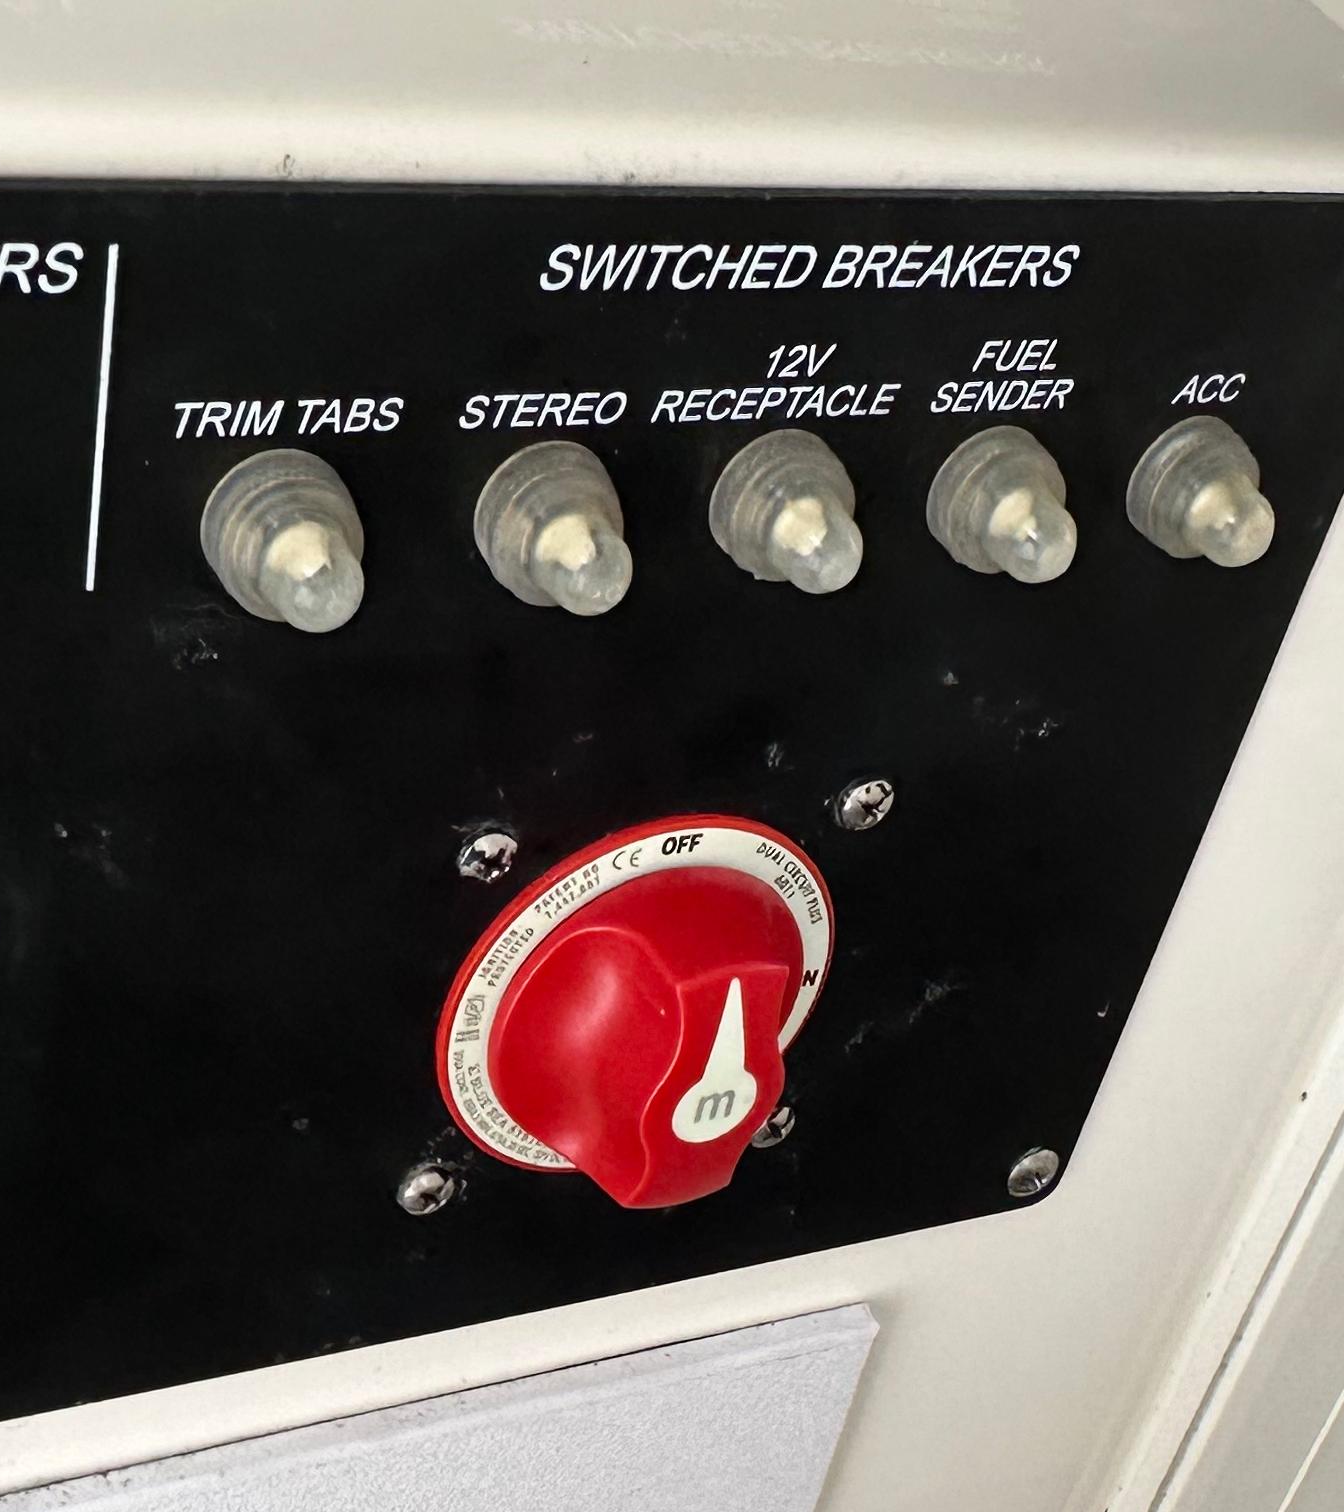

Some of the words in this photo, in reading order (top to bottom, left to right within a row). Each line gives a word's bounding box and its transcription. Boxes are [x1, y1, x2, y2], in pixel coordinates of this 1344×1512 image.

[540, 244, 818, 292] SWITCHED
[821, 245, 1081, 289] BREAKERS
[766, 343, 837, 378] 12V
[972, 338, 1058, 373] FUEL
[651, 383, 902, 423] RECEPTACLE
[930, 378, 1075, 412] SENDER
[1171, 373, 1246, 404] ACC
[175, 399, 284, 439] TRIM
[298, 396, 404, 434] TABS
[458, 391, 628, 430] STEREO
[661, 833, 704, 857] OFF
[802, 969, 819, 987] N
